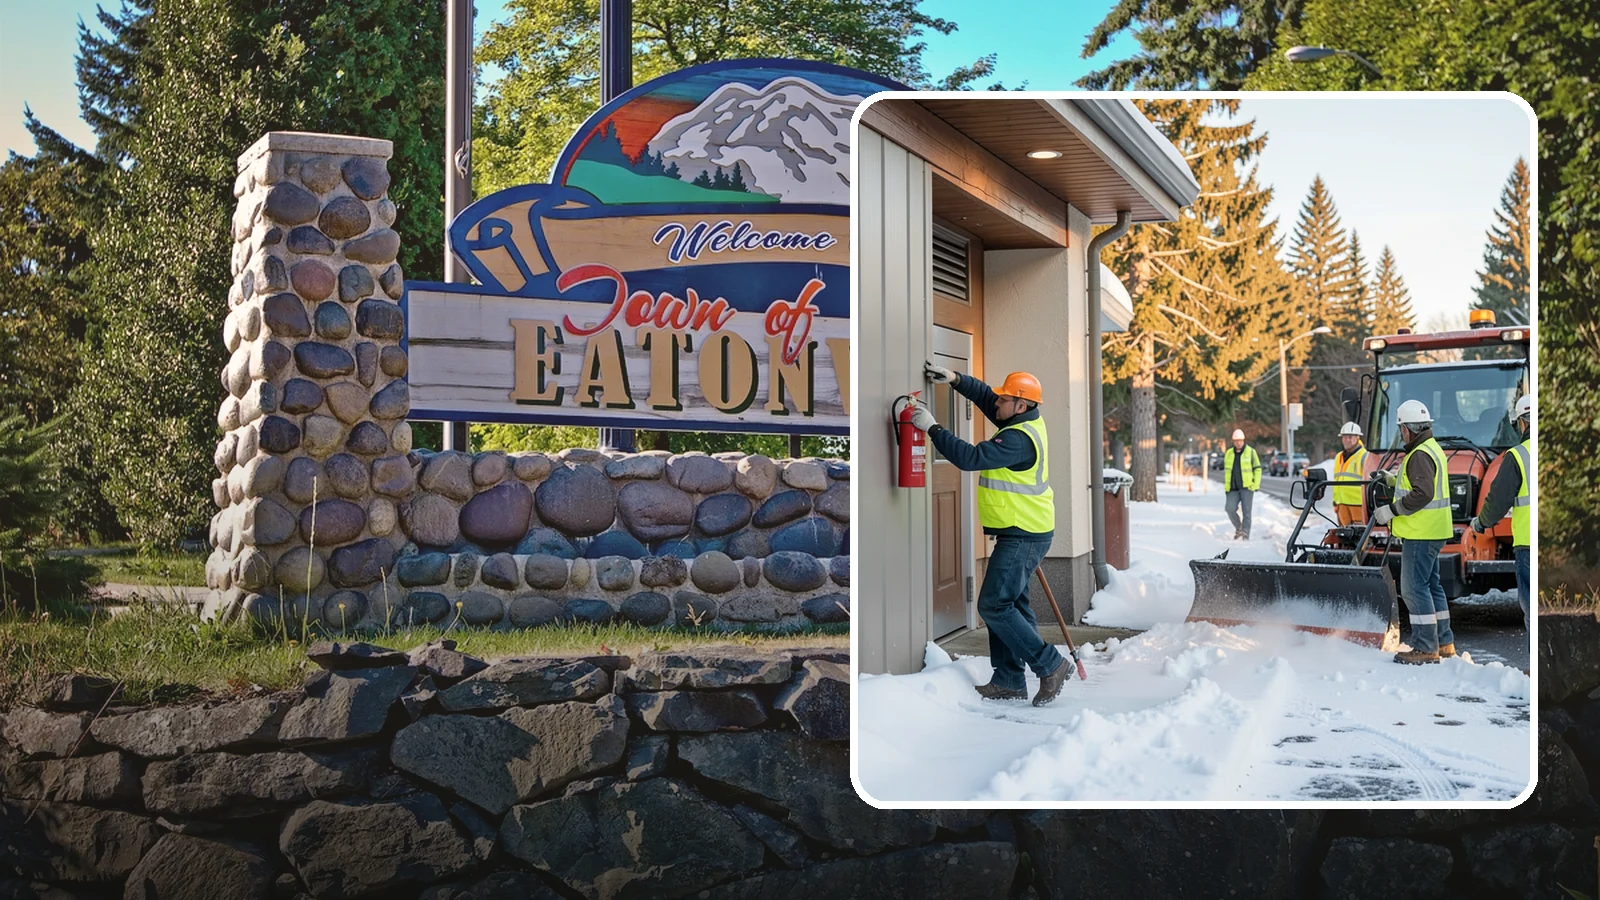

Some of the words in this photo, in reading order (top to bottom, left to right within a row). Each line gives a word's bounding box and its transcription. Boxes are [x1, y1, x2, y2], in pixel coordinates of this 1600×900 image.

[654, 221, 837, 263] Welcome
[556, 263, 736, 336] Town
[764, 277, 826, 366] of
